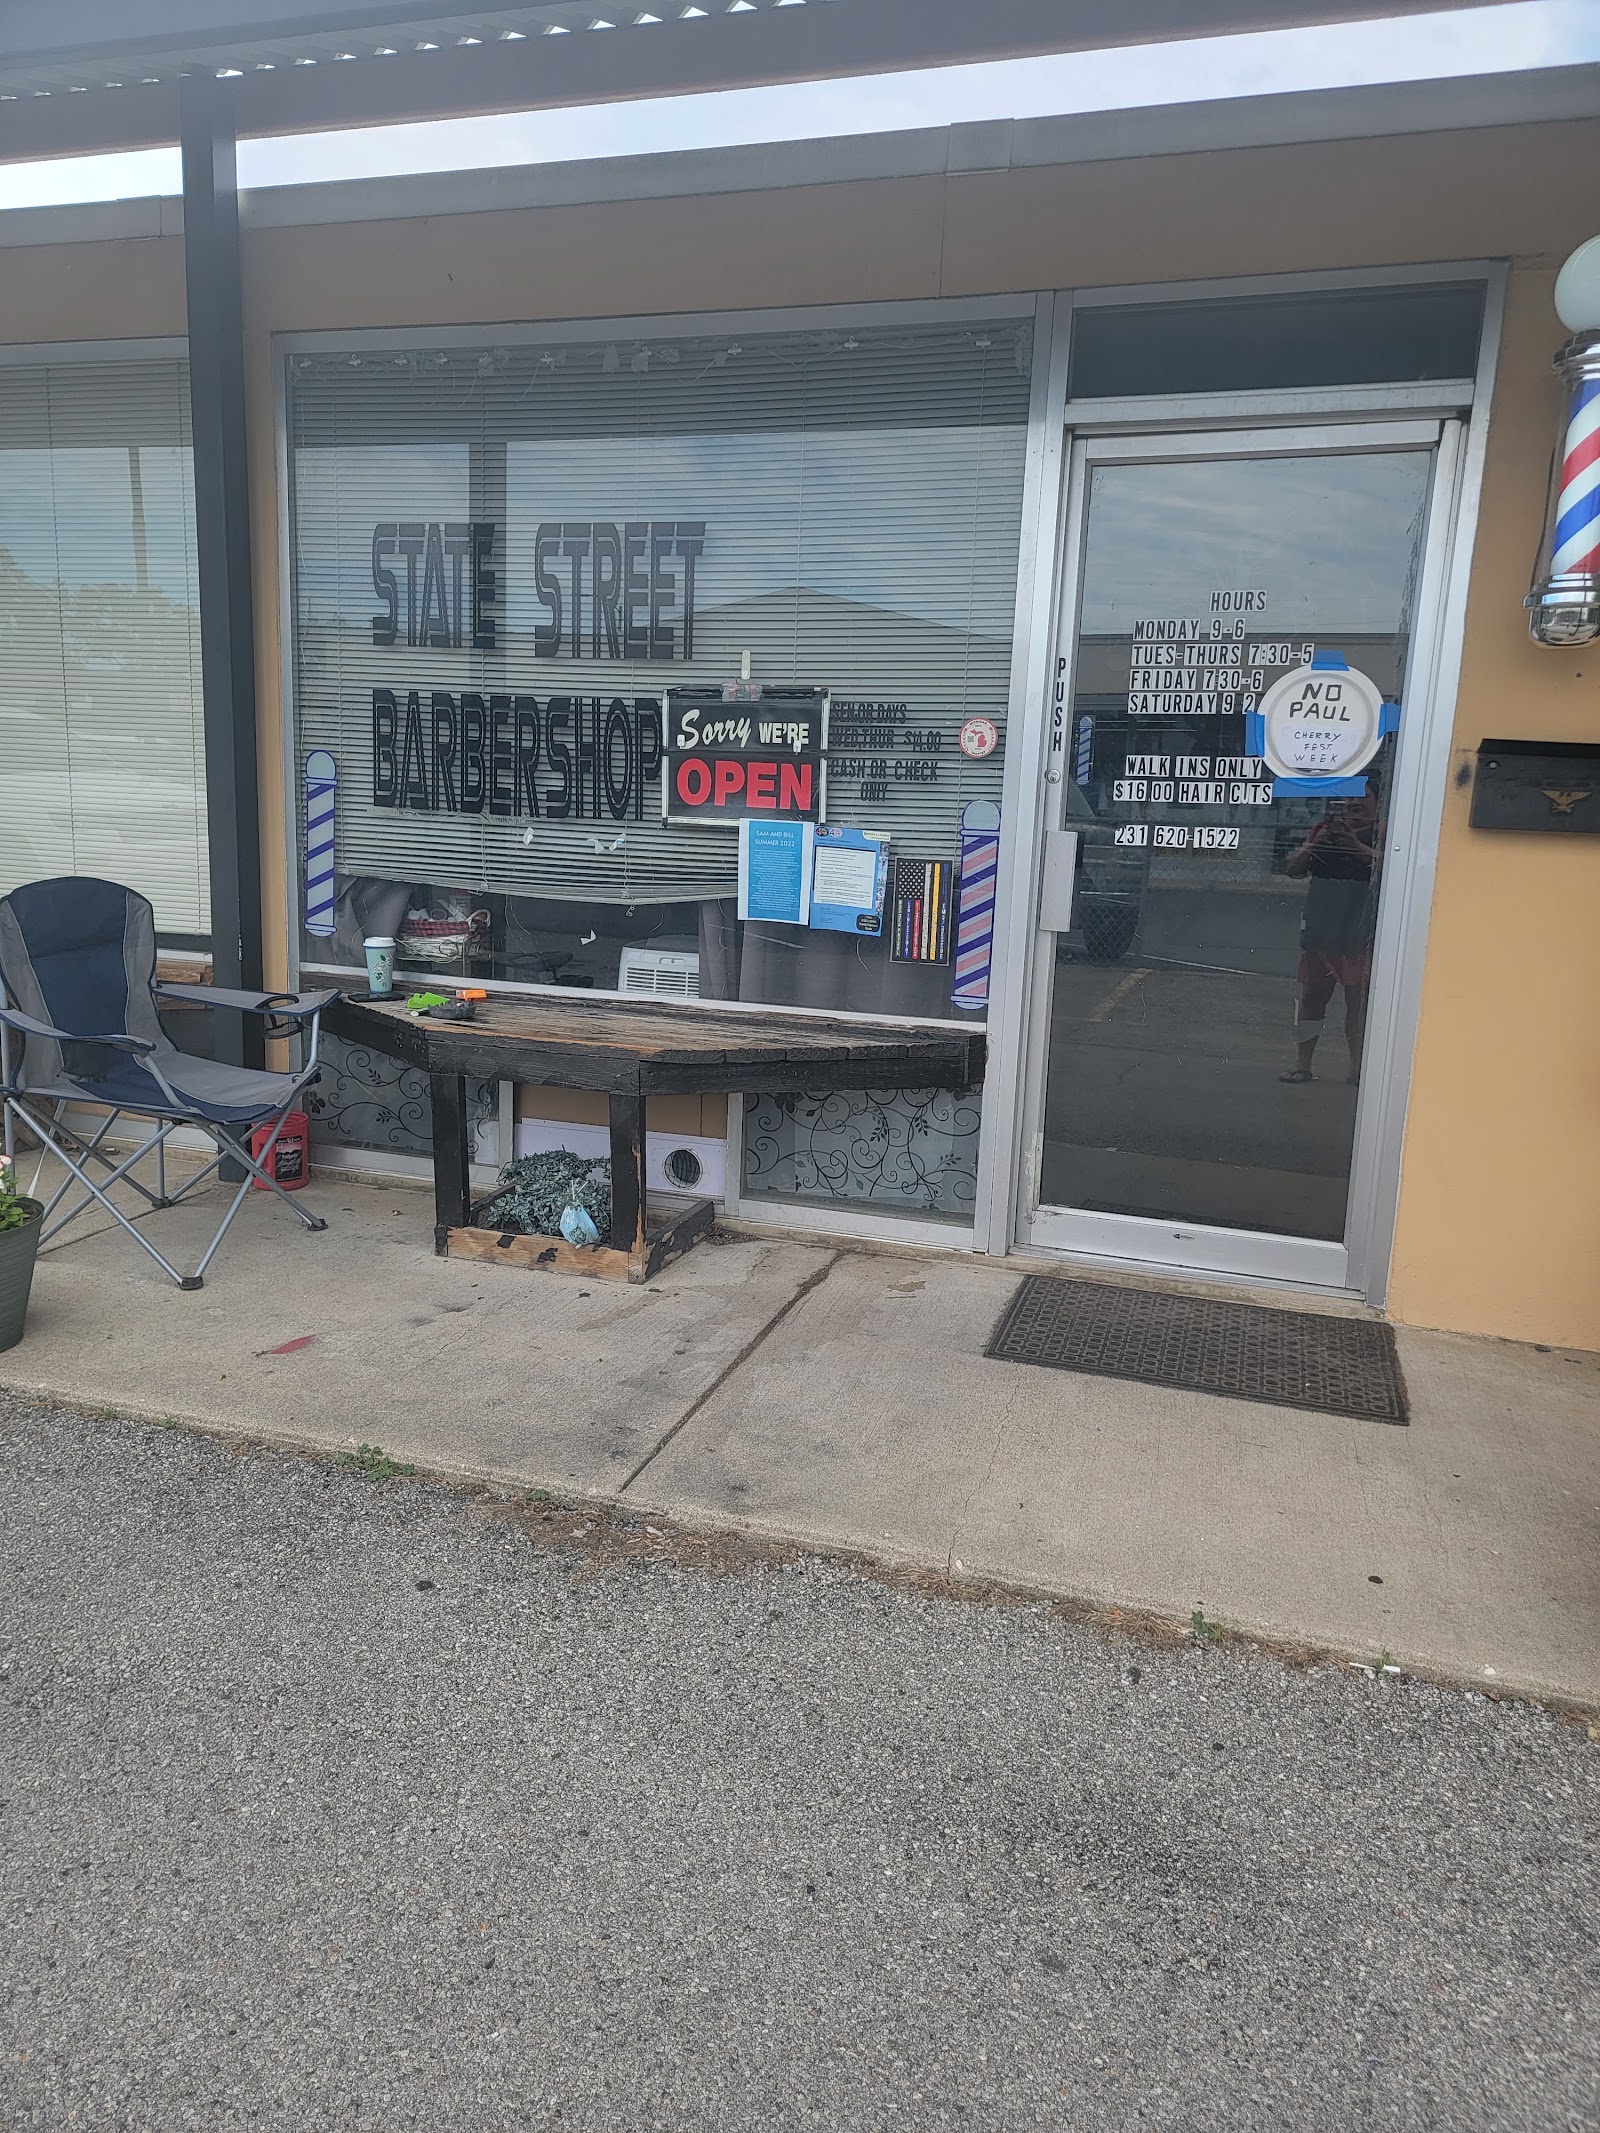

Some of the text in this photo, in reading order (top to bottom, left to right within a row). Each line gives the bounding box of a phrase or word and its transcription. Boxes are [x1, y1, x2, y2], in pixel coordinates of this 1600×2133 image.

[372, 522, 706, 660] STATE STREET
[1210, 591, 1266, 611] HOURS
[1134, 619, 1245, 640] MONDAY 9-6
[1133, 644, 1313, 665] TUES-THURS 7:30-5
[1131, 670, 1262, 690] FRIDAY 7:30-6
[1302, 682, 1342, 702] NO
[831, 702, 908, 724] SENOR DAYS
[1053, 657, 1066, 752] PUSH
[1129, 694, 1216, 713] SATURDAY
[1289, 701, 1350, 722] PAUL
[679, 708, 810, 750] Sorry WE'RE
[1294, 731, 1341, 742] CHERRY
[373, 689, 660, 821] BARBERSHOP
[1293, 753, 1338, 763] WEEK
[831, 758, 938, 782] CASH OR CHECK
[1127, 756, 1261, 778] WALK INS ONLY
[676, 758, 813, 811] OPEN
[1180, 783, 1223, 803] HAIR
[1116, 826, 1238, 848] 231 620-1522
